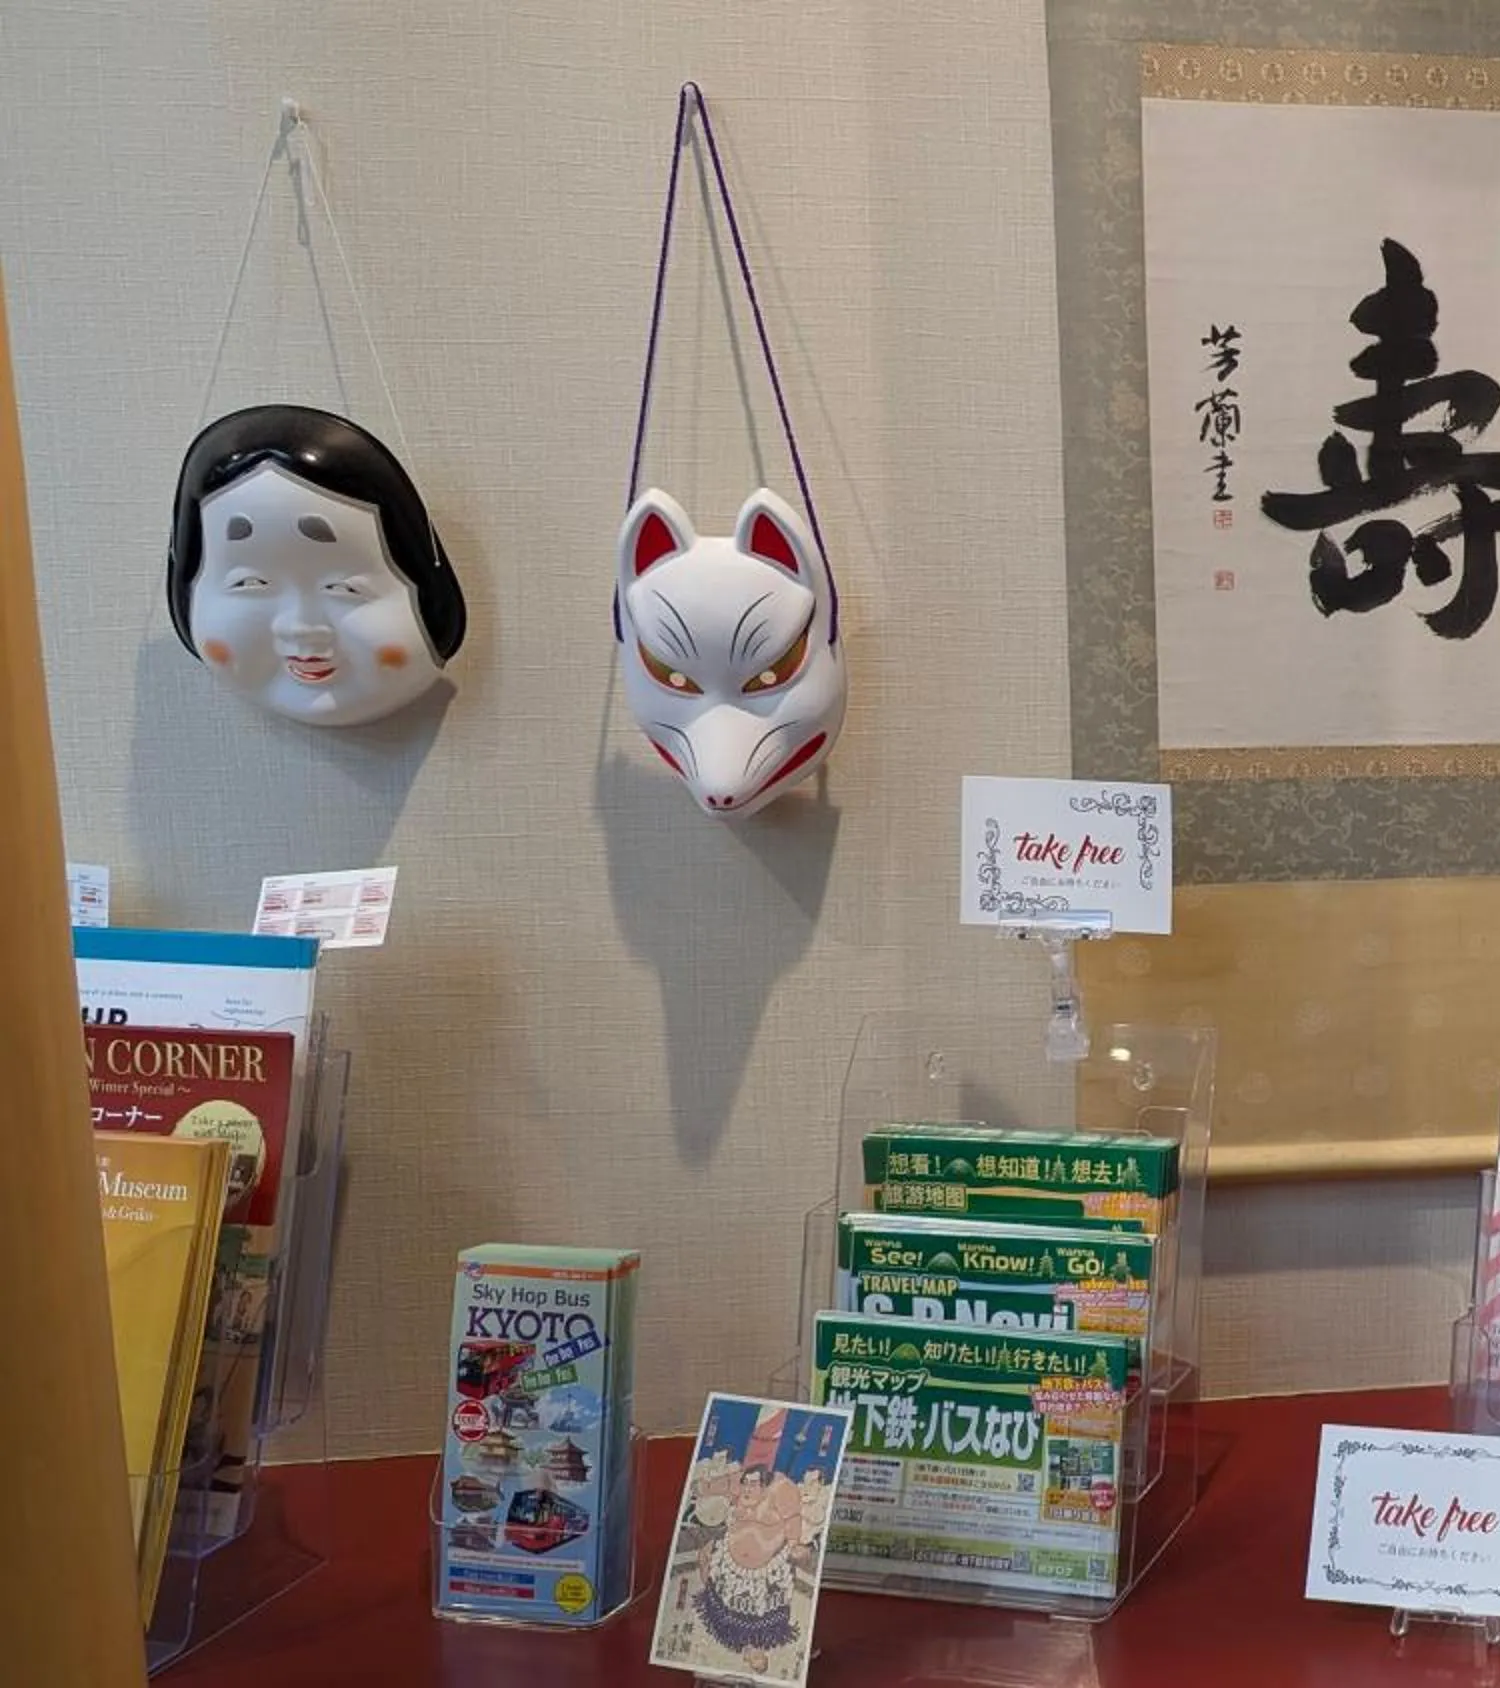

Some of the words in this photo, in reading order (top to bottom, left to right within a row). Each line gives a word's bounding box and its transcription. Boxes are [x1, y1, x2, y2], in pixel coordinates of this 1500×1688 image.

[1014, 831, 1071, 869] take
[1071, 835, 1125, 874] free
[107, 1039, 267, 1083] CORNER
[100, 1170, 188, 1201] Museum
[870, 1247, 923, 1268] See!
[963, 1252, 1035, 1271] Know!
[1067, 1257, 1105, 1276] GO!
[472, 1284, 506, 1305] Sky
[511, 1287, 548, 1308] Hop
[555, 1290, 590, 1307] Bus
[860, 1275, 922, 1294] TRAVEL
[924, 1278, 959, 1296] MAP
[466, 1306, 595, 1343] KYOTO
[830, 1365, 928, 1393] 観光マップ
[1371, 1491, 1438, 1538] take
[1437, 1496, 1499, 1542] free
